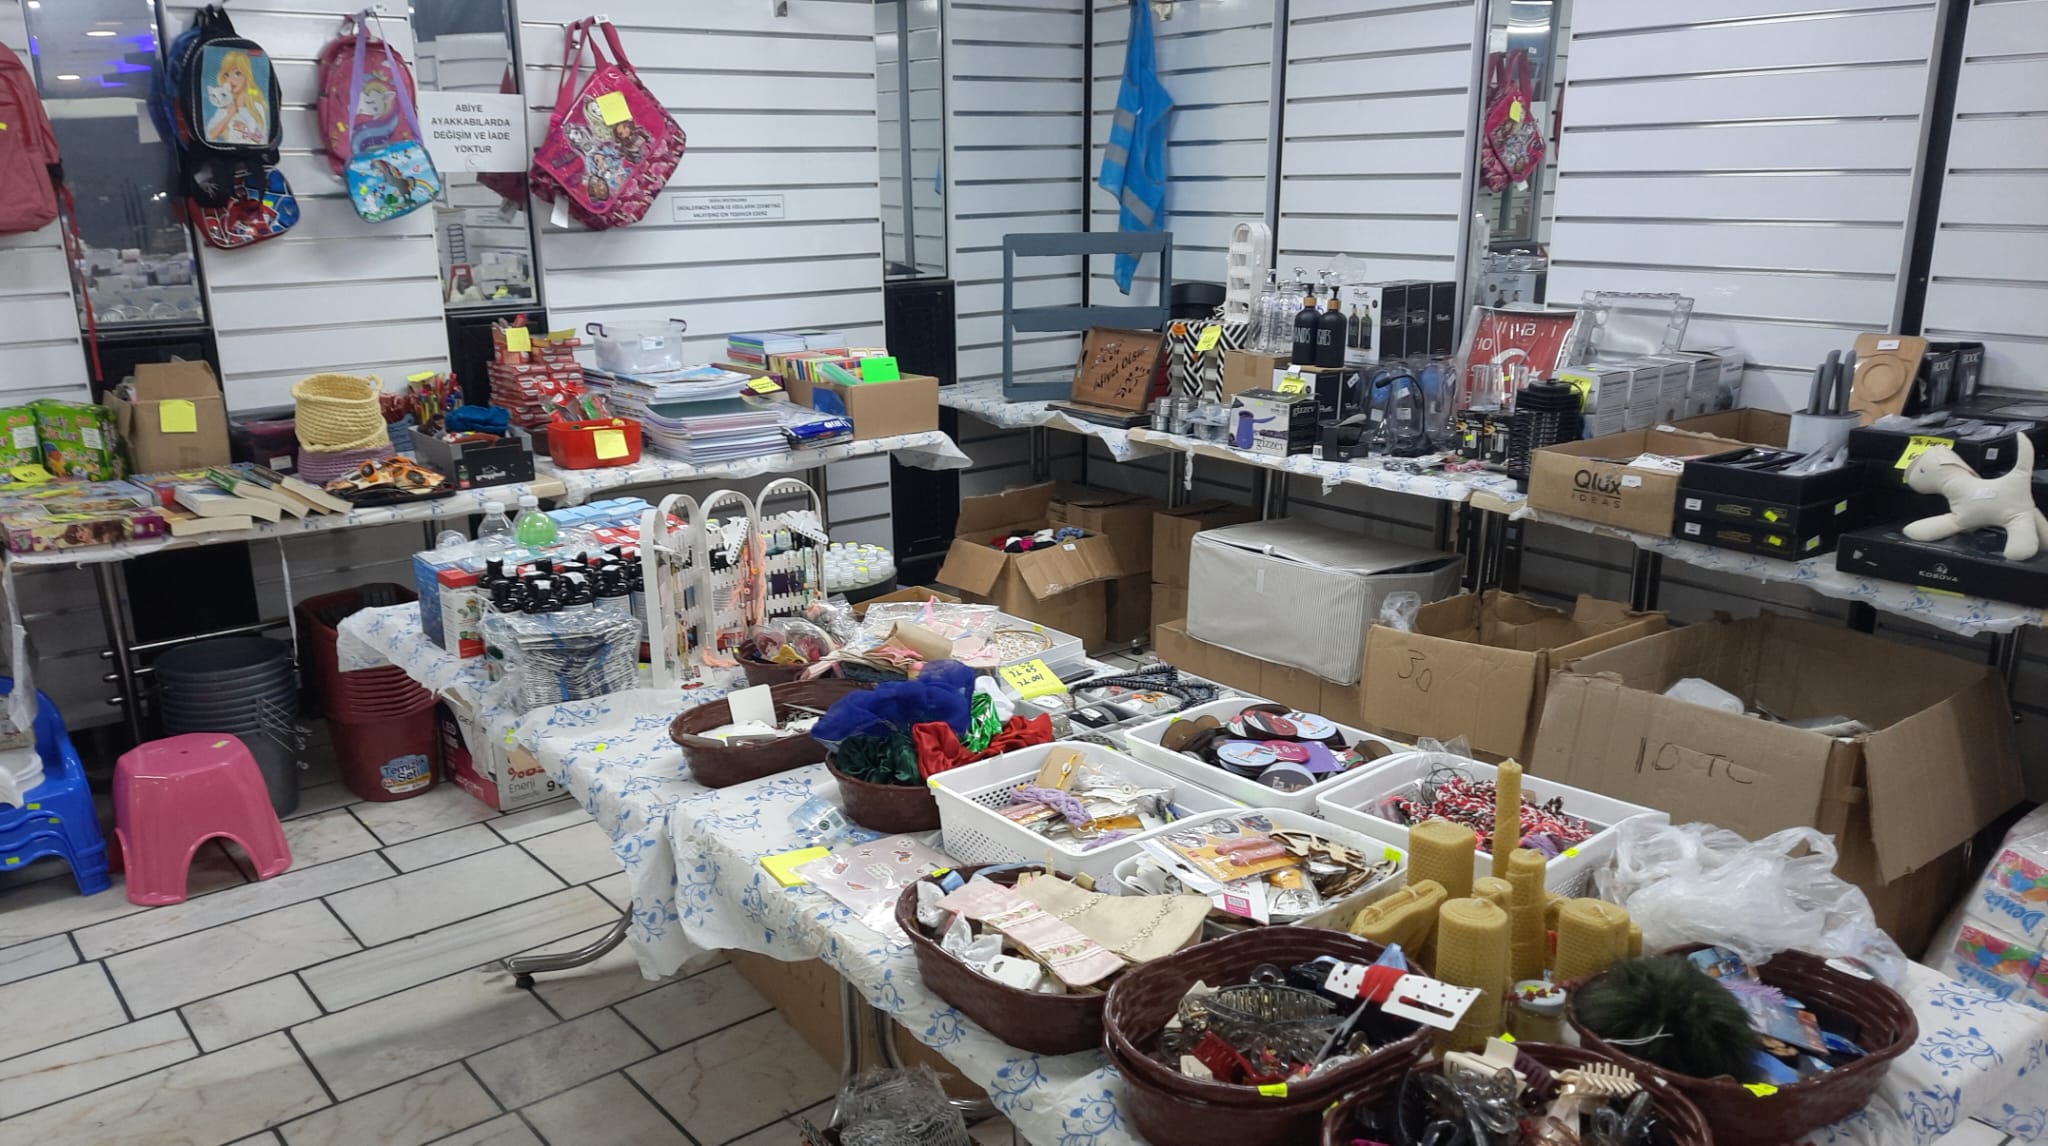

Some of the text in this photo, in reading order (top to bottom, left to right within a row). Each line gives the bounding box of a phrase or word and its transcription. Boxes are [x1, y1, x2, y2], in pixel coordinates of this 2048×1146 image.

[456, 104, 484, 113] ABİYE
[431, 117, 511, 127] AYAKKABILARDA
[433, 129, 511, 141] DEĞİŞİM VE İADE
[454, 145, 492, 153] YOKTUR
[1571, 492, 1621, 509] IDEAS
[1918, 569, 1959, 582] KOSOVA
